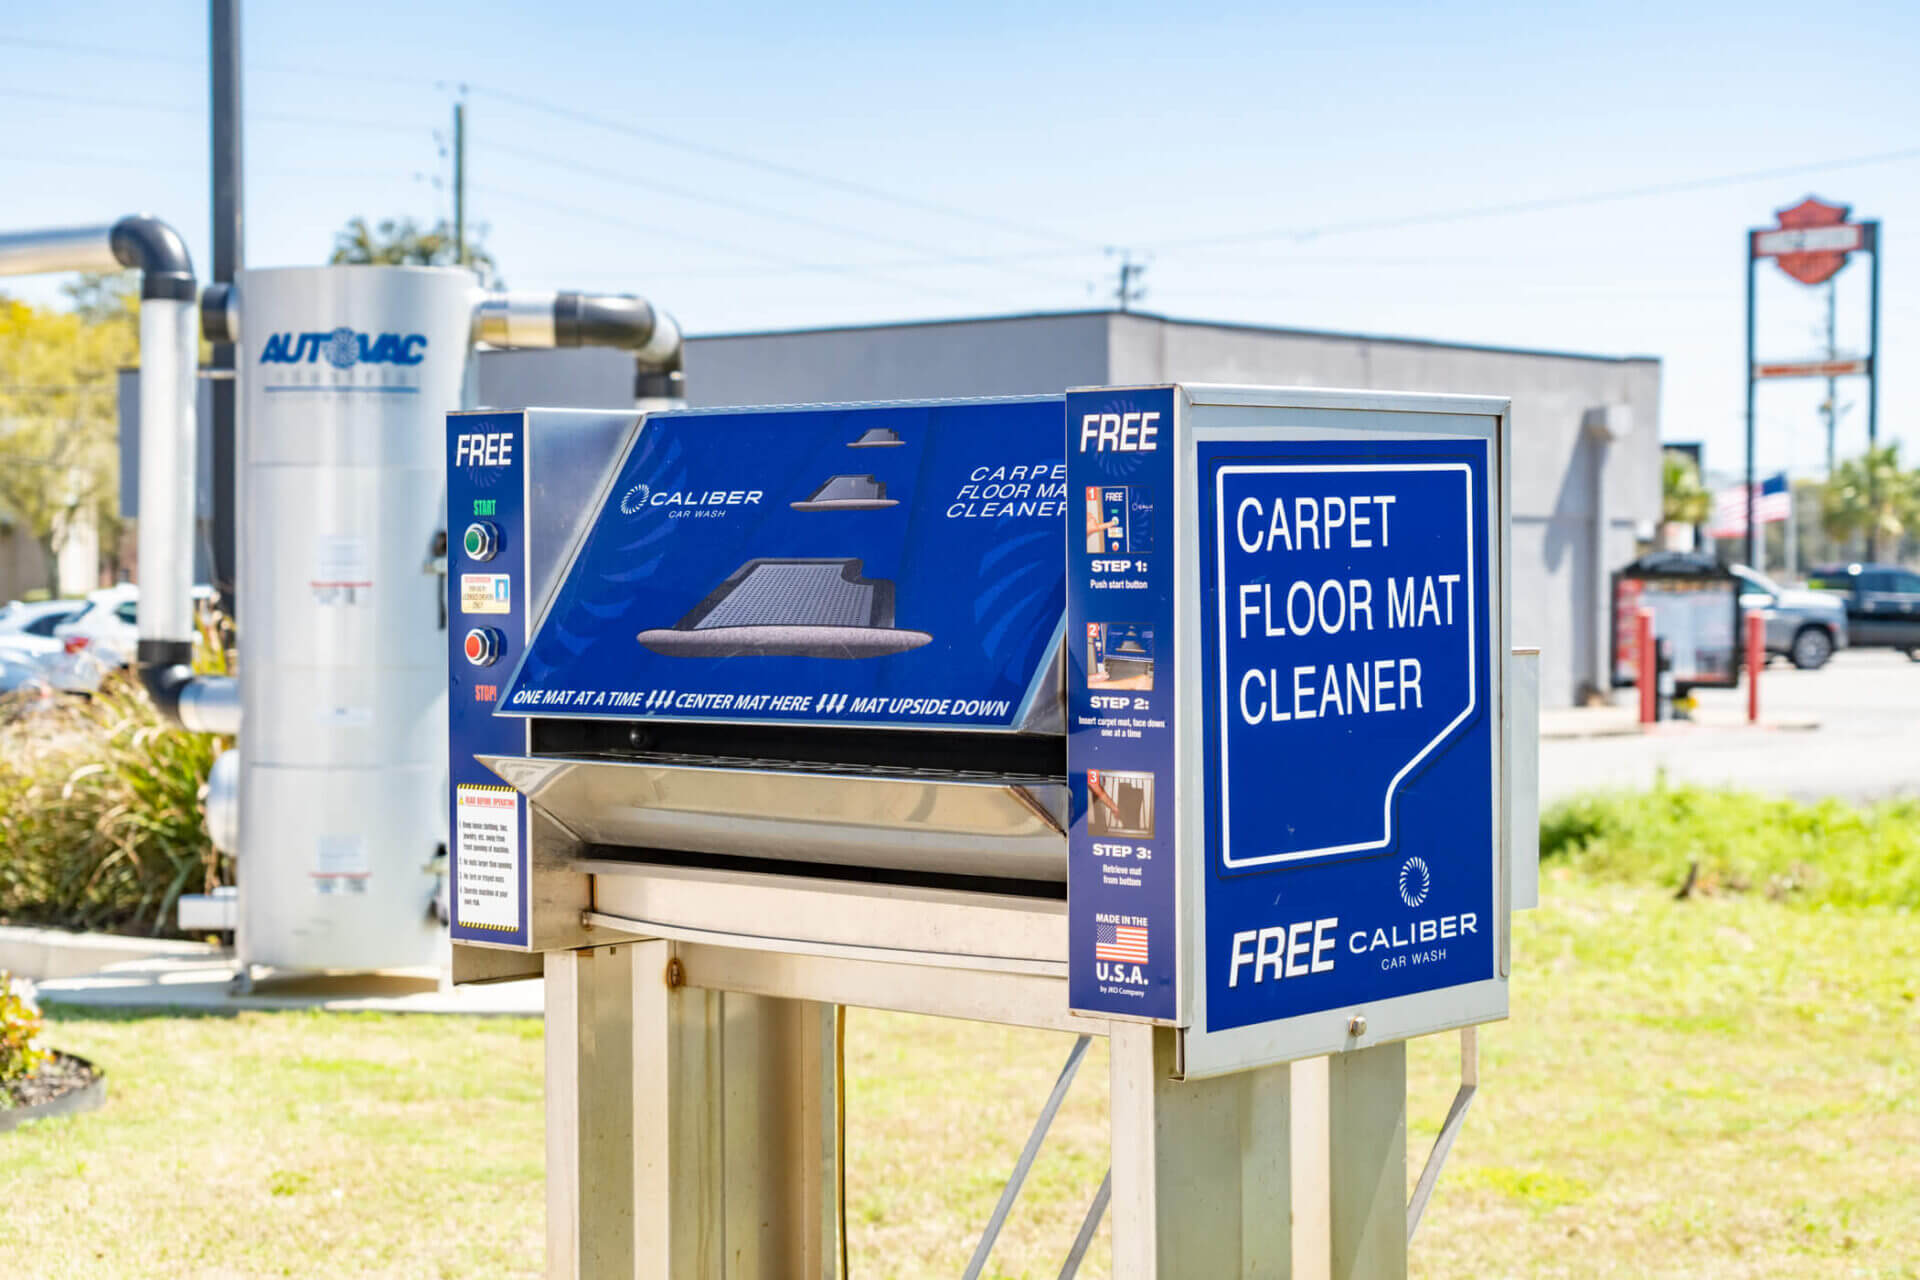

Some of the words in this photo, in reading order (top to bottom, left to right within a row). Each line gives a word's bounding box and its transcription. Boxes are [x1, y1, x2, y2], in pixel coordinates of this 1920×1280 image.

[259, 327, 428, 368] AUTOVAC
[1080, 412, 1160, 453] FREE
[456, 432, 514, 467] FREE
[970, 464, 1066, 481] CARPE
[650, 490, 763, 506] CALIBER
[956, 483, 1031, 499] FLOOR
[1036, 483, 1066, 498] MA
[1089, 488, 1095, 499] 1
[1105, 491, 1124, 502] FREE
[473, 499, 497, 516] START
[668, 510, 690, 519] CAR
[695, 509, 726, 518] WASH
[1236, 495, 1396, 553] CARPET
[1091, 560, 1131, 573] STEP
[1135, 560, 1148, 572] 1:
[1090, 579, 1107, 589] Push
[1109, 579, 1124, 589] start
[1125, 579, 1148, 589] button
[1239, 579, 1374, 639] FLOOR
[1387, 574, 1460, 629] MAT
[1089, 624, 1097, 636] 2
[475, 685, 497, 701] STOP!
[1239, 658, 1423, 726] CLEANER
[512, 690, 543, 704] ONE
[543, 690, 576, 705] MAT
[573, 690, 595, 706] AT
[593, 691, 605, 706] A
[608, 691, 645, 707] TIME
[675, 693, 738, 709] CENTER
[736, 694, 770, 710] MAT
[769, 695, 813, 711] HERE
[850, 697, 888, 713] MAT
[888, 698, 950, 715] UPSIDE
[951, 700, 1010, 717] DOWN
[1090, 696, 1130, 709] STEP
[1133, 698, 1149, 710] 2:
[1089, 770, 1097, 783] 3
[1092, 843, 1132, 858] STEP
[1136, 847, 1152, 860] 3:
[1102, 864, 1128, 875] Retrieve
[1103, 875, 1119, 885] from
[1119, 876, 1142, 887] bottom
[1095, 913, 1120, 925] MADE
[1121, 915, 1130, 925] IN
[1130, 916, 1148, 927] THE
[1349, 912, 1478, 954] CALIBER
[1228, 917, 1339, 988] FREE
[1381, 956, 1406, 971] CAR
[1411, 949, 1447, 966] WASH
[1096, 962, 1149, 985] U.S.A.
